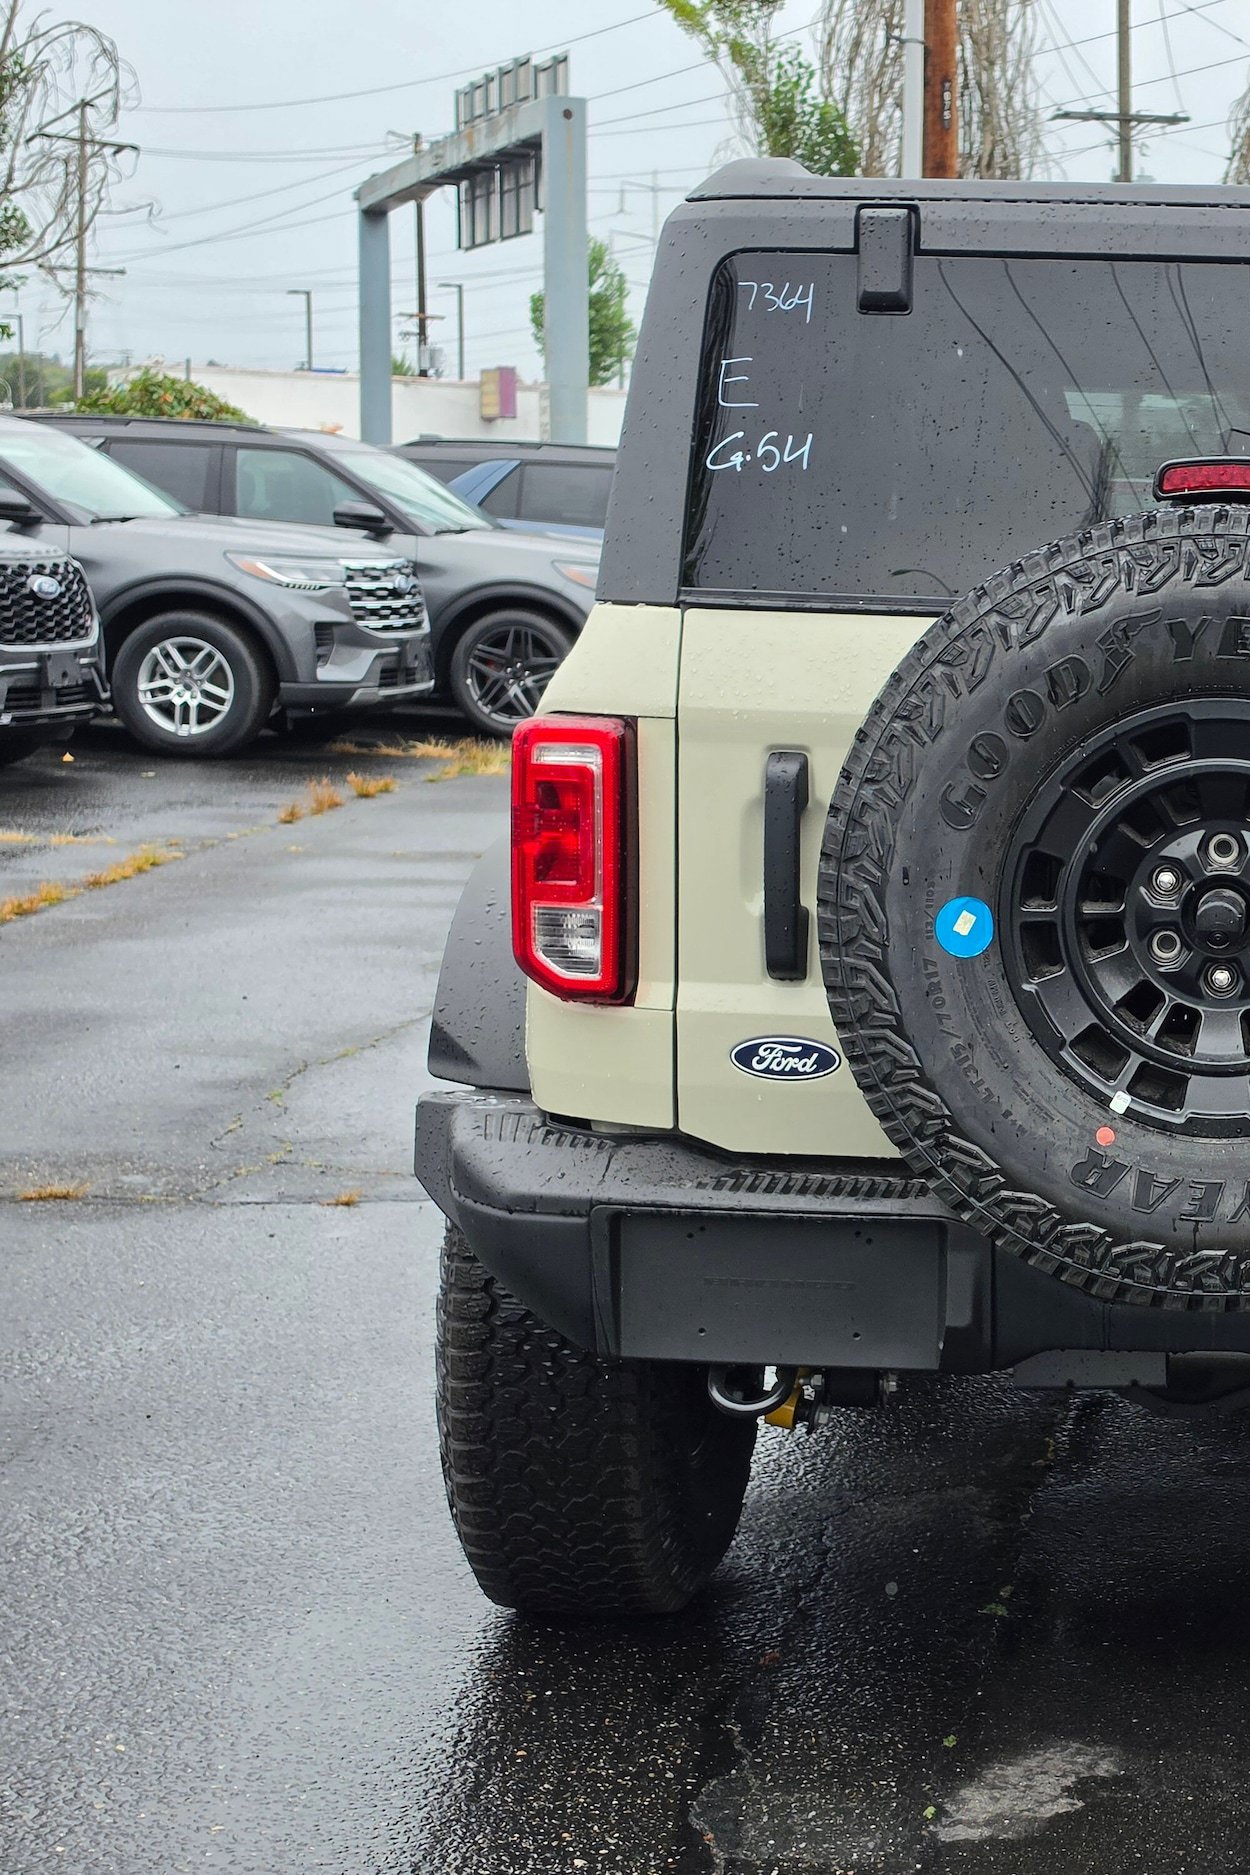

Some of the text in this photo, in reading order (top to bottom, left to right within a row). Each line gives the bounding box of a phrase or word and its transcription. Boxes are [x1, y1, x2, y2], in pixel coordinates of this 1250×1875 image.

[737, 281, 815, 324] 7364
[718, 357, 760, 407] E
[921, 956, 995, 1105] LT315/70R17
[751, 1042, 819, 1073] Ford
